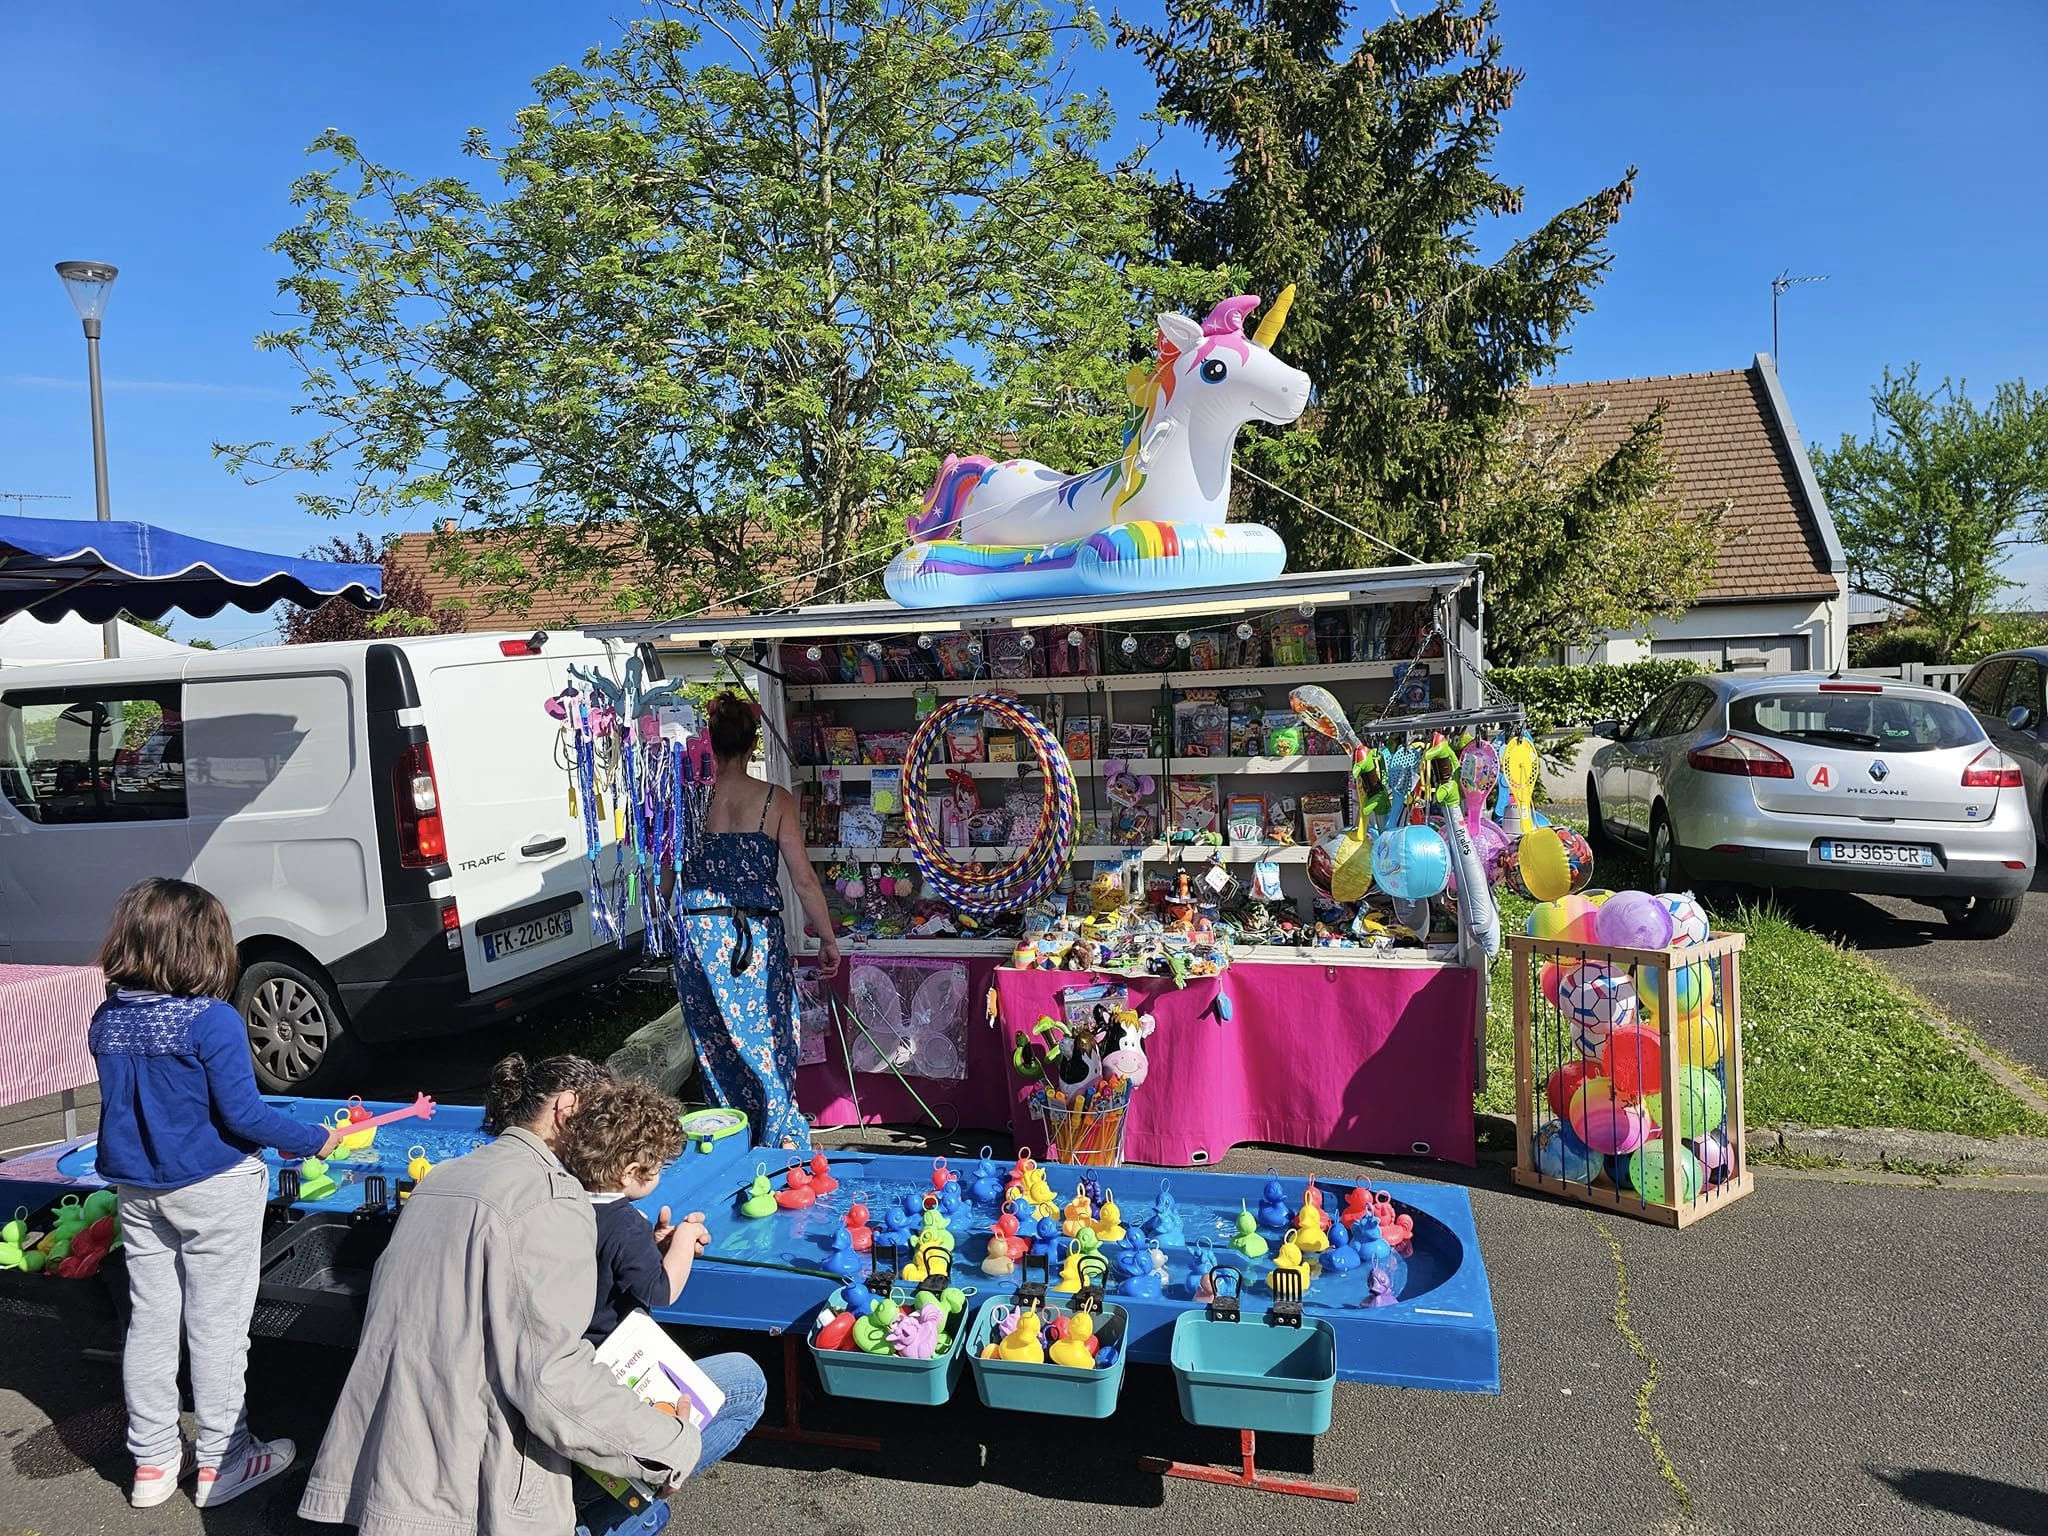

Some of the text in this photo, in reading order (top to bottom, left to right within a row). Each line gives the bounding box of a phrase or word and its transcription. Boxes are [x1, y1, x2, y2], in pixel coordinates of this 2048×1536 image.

[1812, 767, 1830, 788] A
[1847, 787, 1909, 797] MEGANE
[458, 852, 507, 872] TRAFIC
[1834, 843, 1920, 864] BJ-965-CR
[493, 913, 564, 954] FK-220-GK
[624, 1349, 644, 1369] verte
